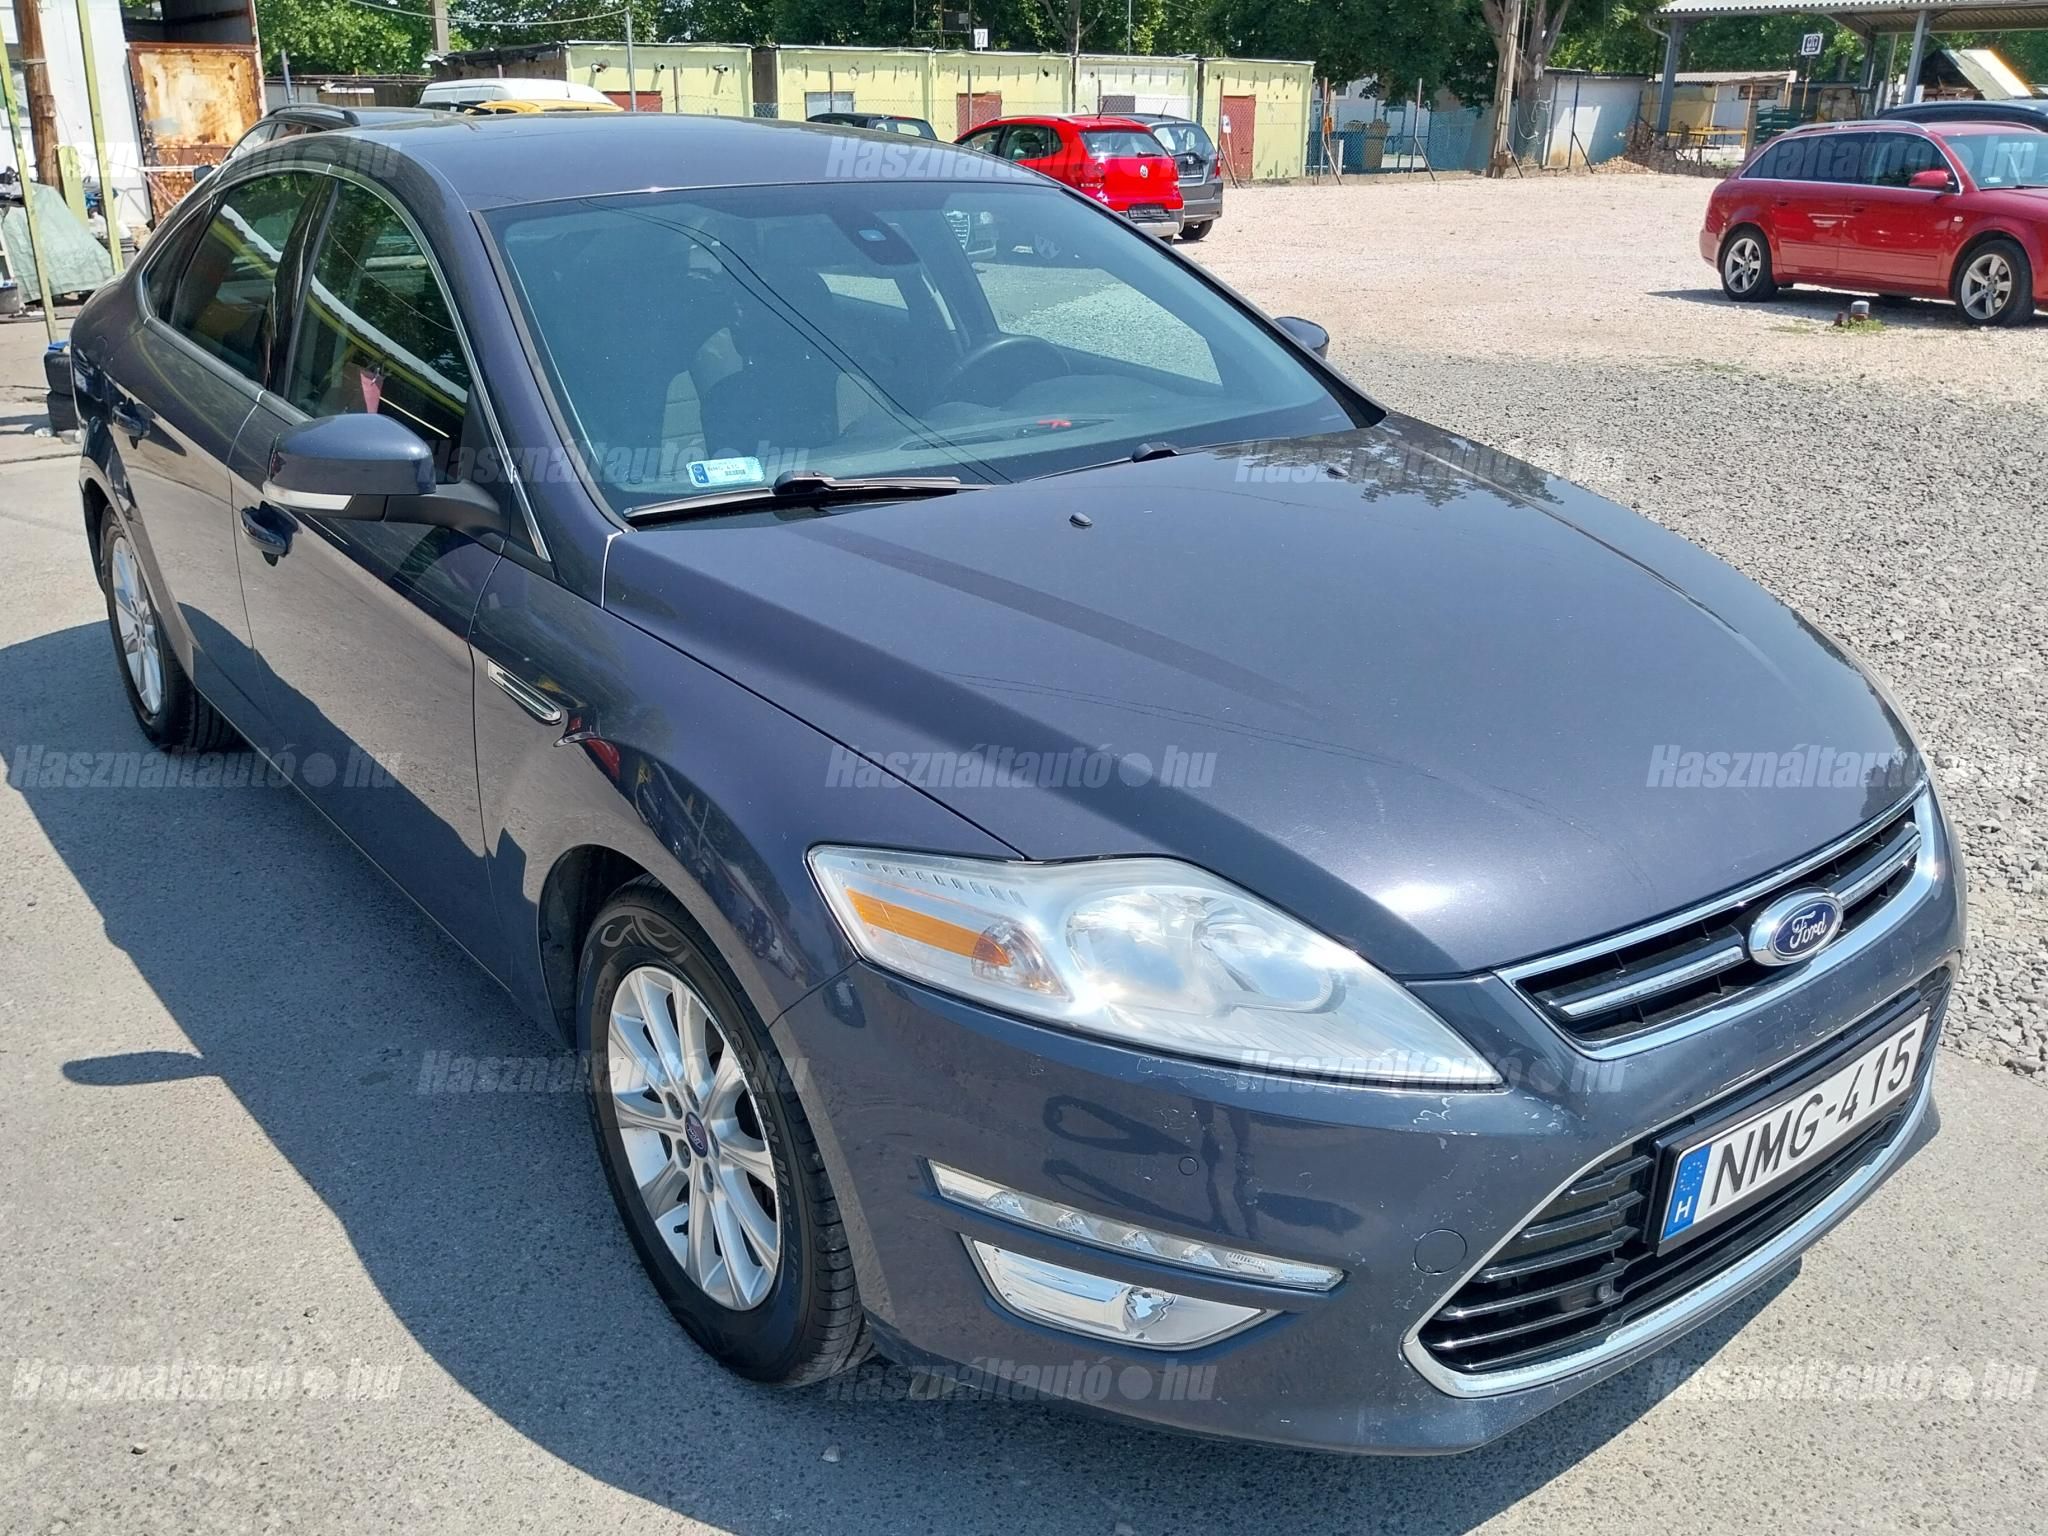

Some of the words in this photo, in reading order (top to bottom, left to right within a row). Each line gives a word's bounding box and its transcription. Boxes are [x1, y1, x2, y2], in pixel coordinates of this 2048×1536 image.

[977, 31, 986, 45] 27
[1789, 910, 1828, 949] Ford
[1708, 1028, 1917, 1208] NMG-415
[1674, 1196, 1693, 1223] H
